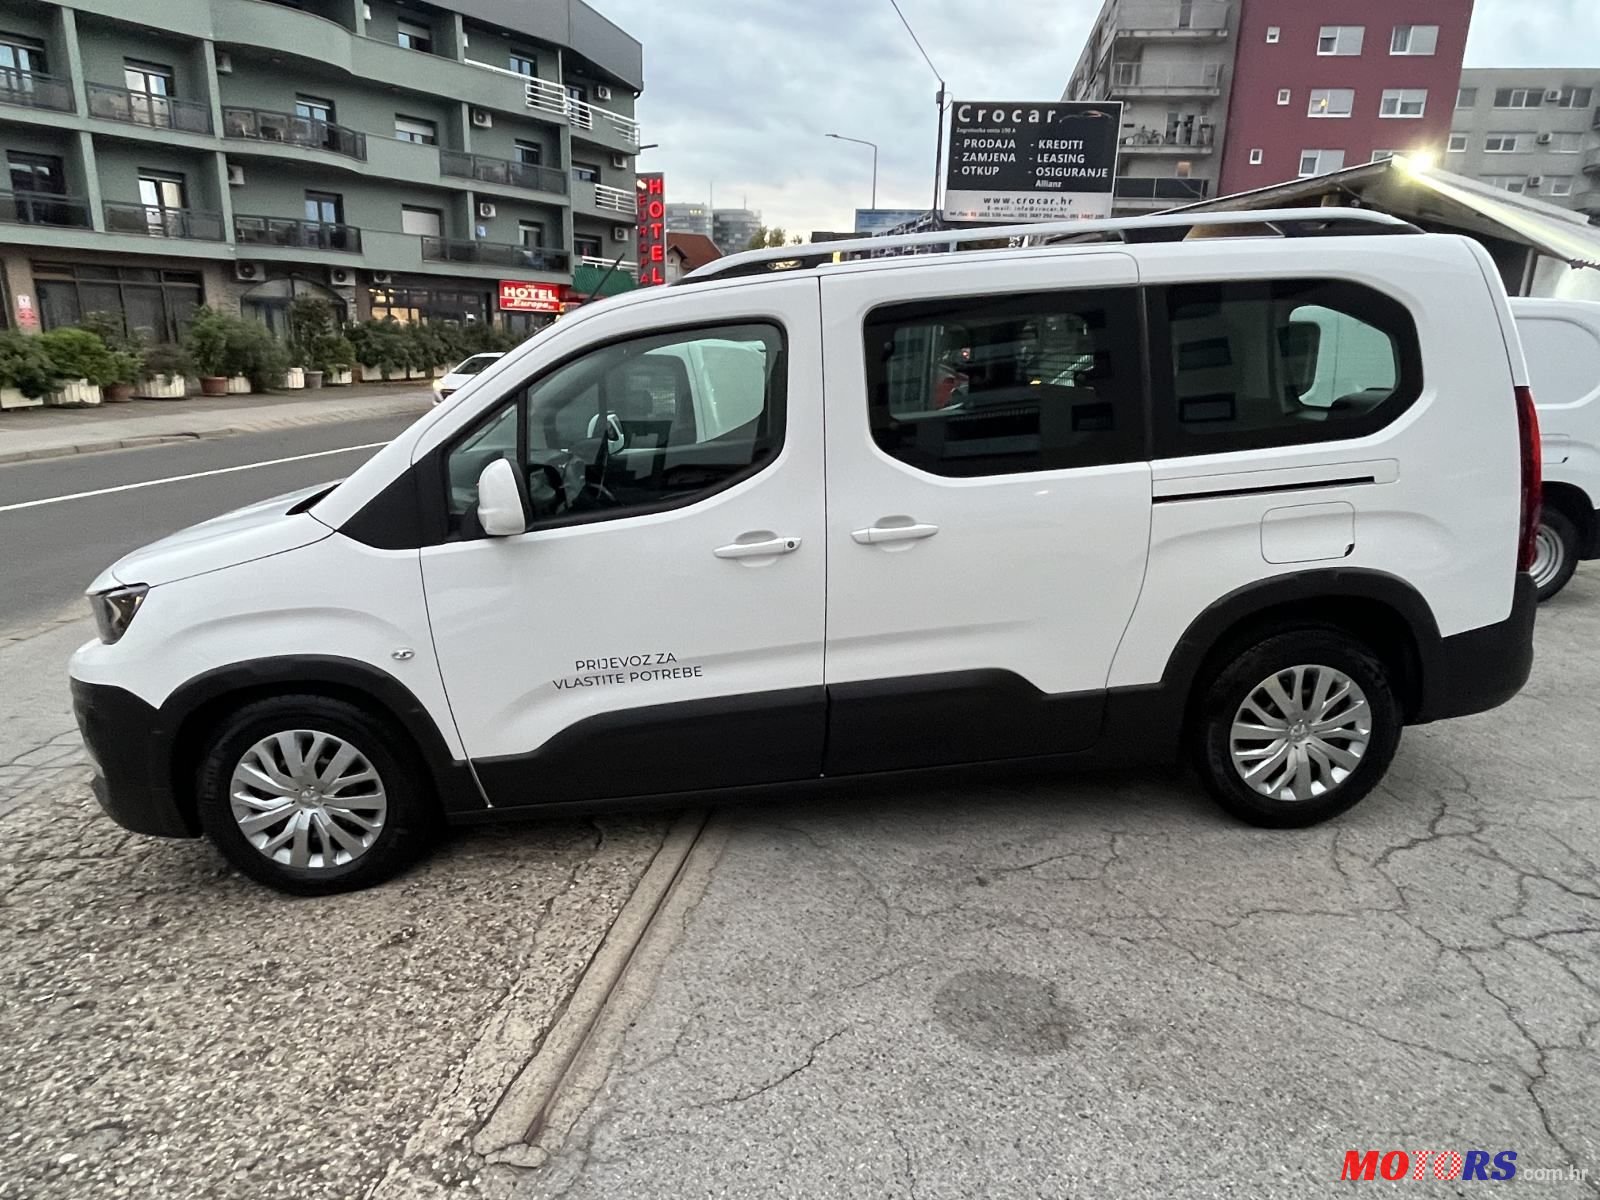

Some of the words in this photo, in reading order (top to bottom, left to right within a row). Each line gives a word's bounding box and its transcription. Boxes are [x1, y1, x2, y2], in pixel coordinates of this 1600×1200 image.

[957, 104, 1056, 123] Crocar
[963, 138, 1016, 149] PRODAJA
[1038, 139, 1083, 150] KREDITI
[962, 152, 1016, 163] ZAMJENA
[1037, 153, 1085, 164] LEASING
[961, 166, 1000, 176] OTKUP
[1035, 167, 1109, 178] OSIGURANJE
[1035, 179, 1062, 188] Allianz
[983, 196, 1073, 206] www.crocar.hr
[648, 178, 664, 283] HOTEL
[503, 286, 557, 300] HOTEL
[575, 654, 652, 671] PRIJEVOZ
[656, 652, 677, 664] ZA
[552, 672, 625, 690] VLASTITE
[630, 666, 703, 683] POTREBE
